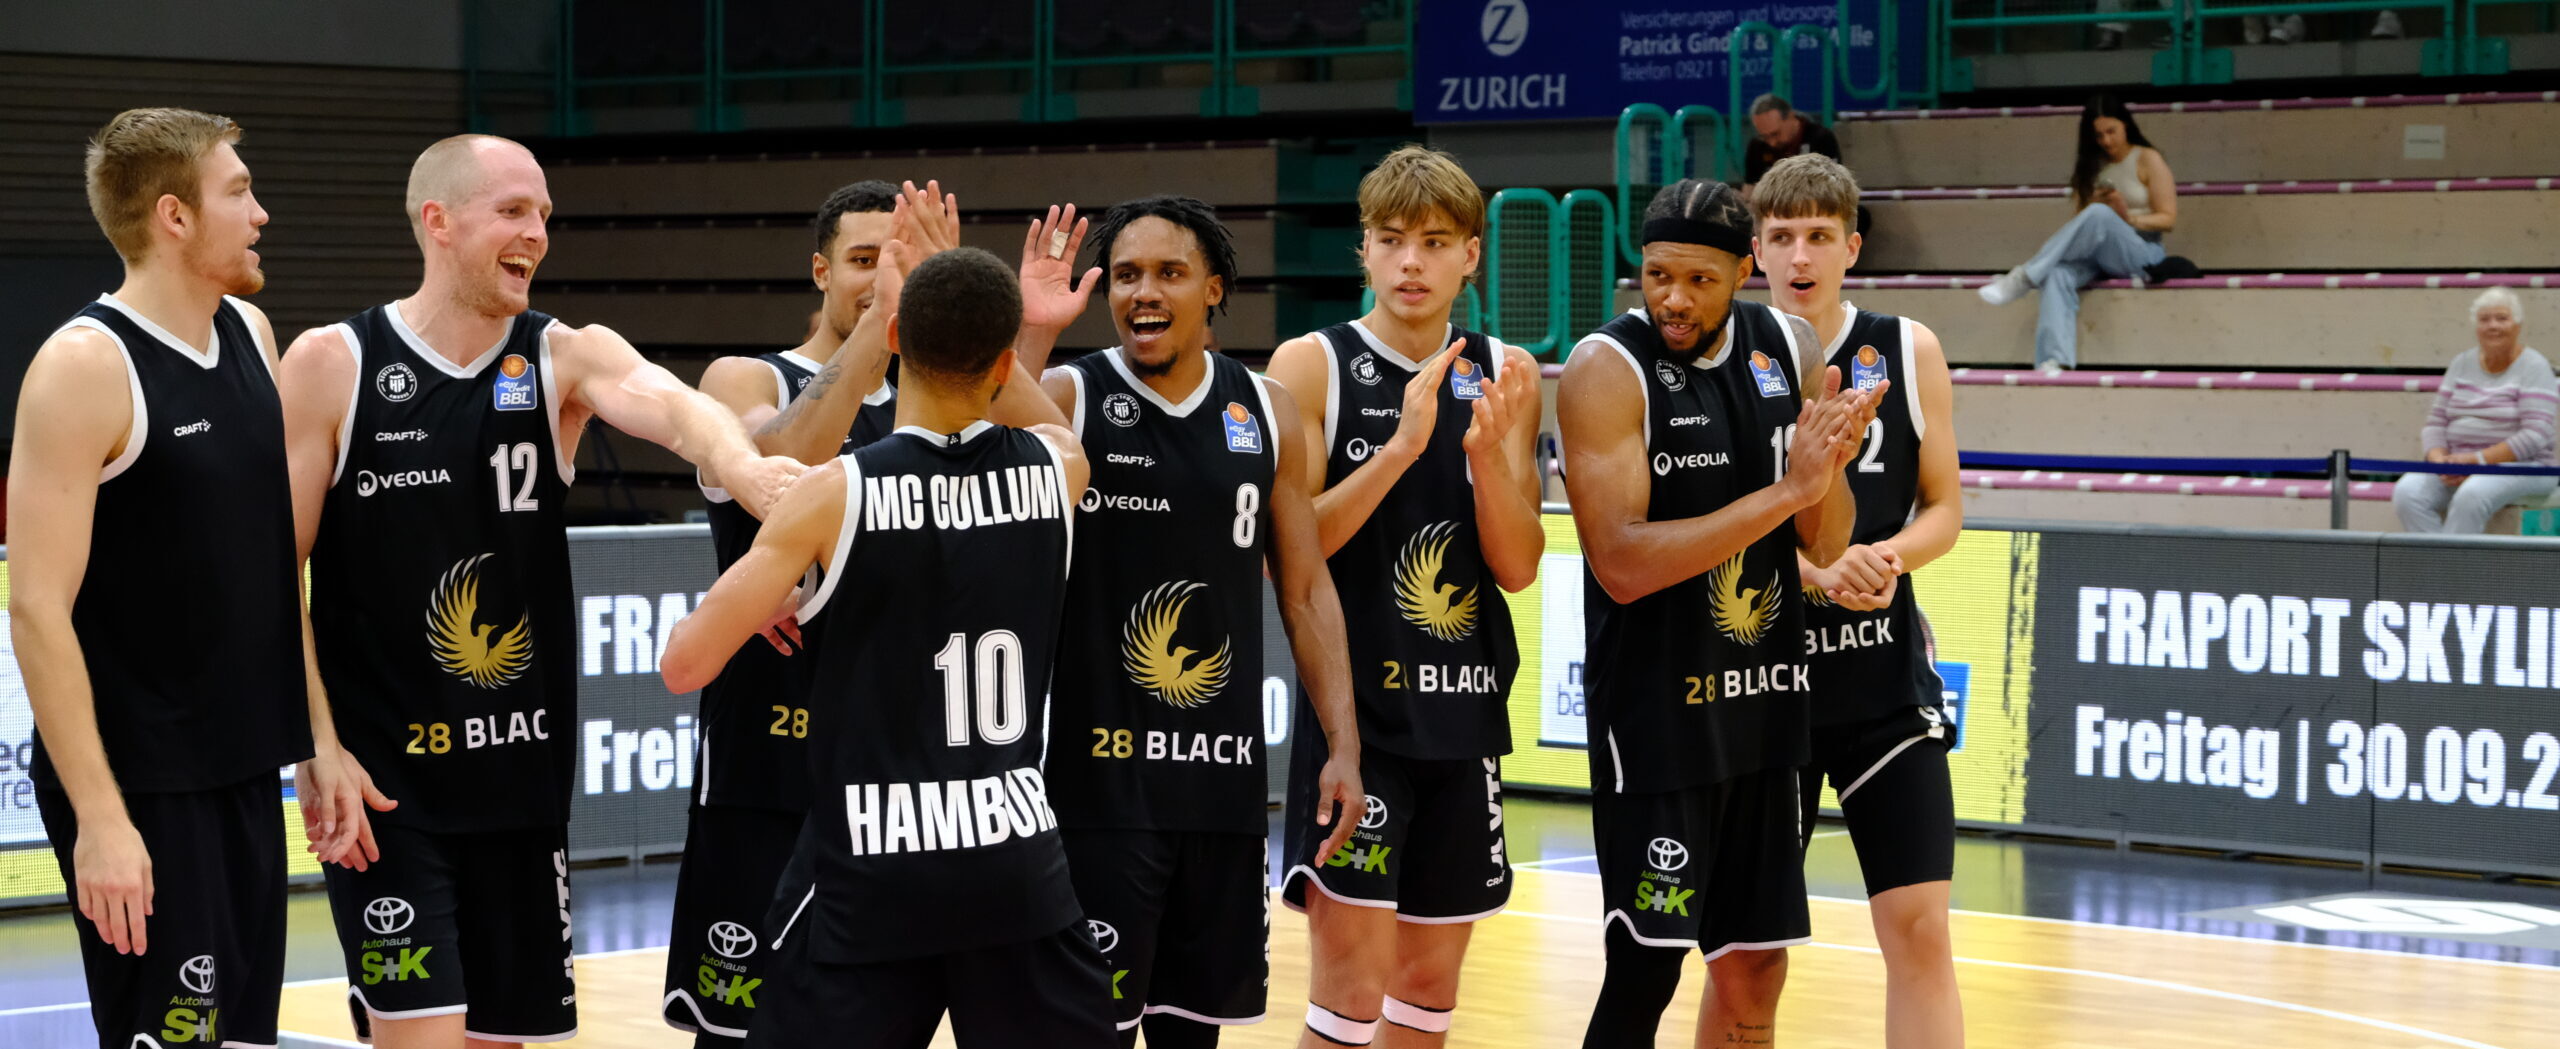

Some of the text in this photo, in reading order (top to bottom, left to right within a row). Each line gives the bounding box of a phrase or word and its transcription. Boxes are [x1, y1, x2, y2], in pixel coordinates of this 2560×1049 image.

[1619, 32, 1682, 57] Patrick
[1619, 60, 1672, 81] Telefon
[1675, 59, 1713, 79] 0921
[1438, 73, 1567, 111] ZURICH
[499, 391, 531, 405] BBL
[1458, 386, 1483, 396] BBL
[1762, 381, 1786, 392] BBL
[174, 422, 204, 437] CRAFT
[1361, 407, 1396, 417] CRAFT
[1669, 416, 1701, 427] CRAFT
[375, 430, 417, 442] CRAFT
[1232, 436, 1257, 449] BBL
[1106, 453, 1145, 465] CRAFT
[1674, 452, 1730, 469] VEOLIA
[379, 468, 451, 489] VEOLIA
[490, 442, 538, 512] 12
[865, 465, 1060, 532] MC CULLUM
[1103, 494, 1171, 512] VEOLIA
[1232, 482, 1260, 548] 8
[582, 592, 708, 676] FRA
[2078, 586, 2351, 678] FRAPORT
[934, 628, 1027, 747] 10
[1383, 660, 1499, 693] 2 BLACK
[1685, 663, 1811, 704] 28 BLACK
[406, 709, 549, 755] 28 BLAC
[769, 704, 809, 739] 28
[1091, 728, 1254, 766] 28 BLACK
[2075, 705, 2280, 799] Freitag
[845, 767, 1058, 856] HAMBUR
[1326, 839, 1392, 875] S+K
[1635, 881, 1696, 917] S+K
[362, 937, 412, 950] Autohaus
[361, 946, 433, 985] S+K
[700, 953, 748, 973] Autohaus
[698, 964, 763, 1008] S+K
[161, 1007, 219, 1043] S+K
